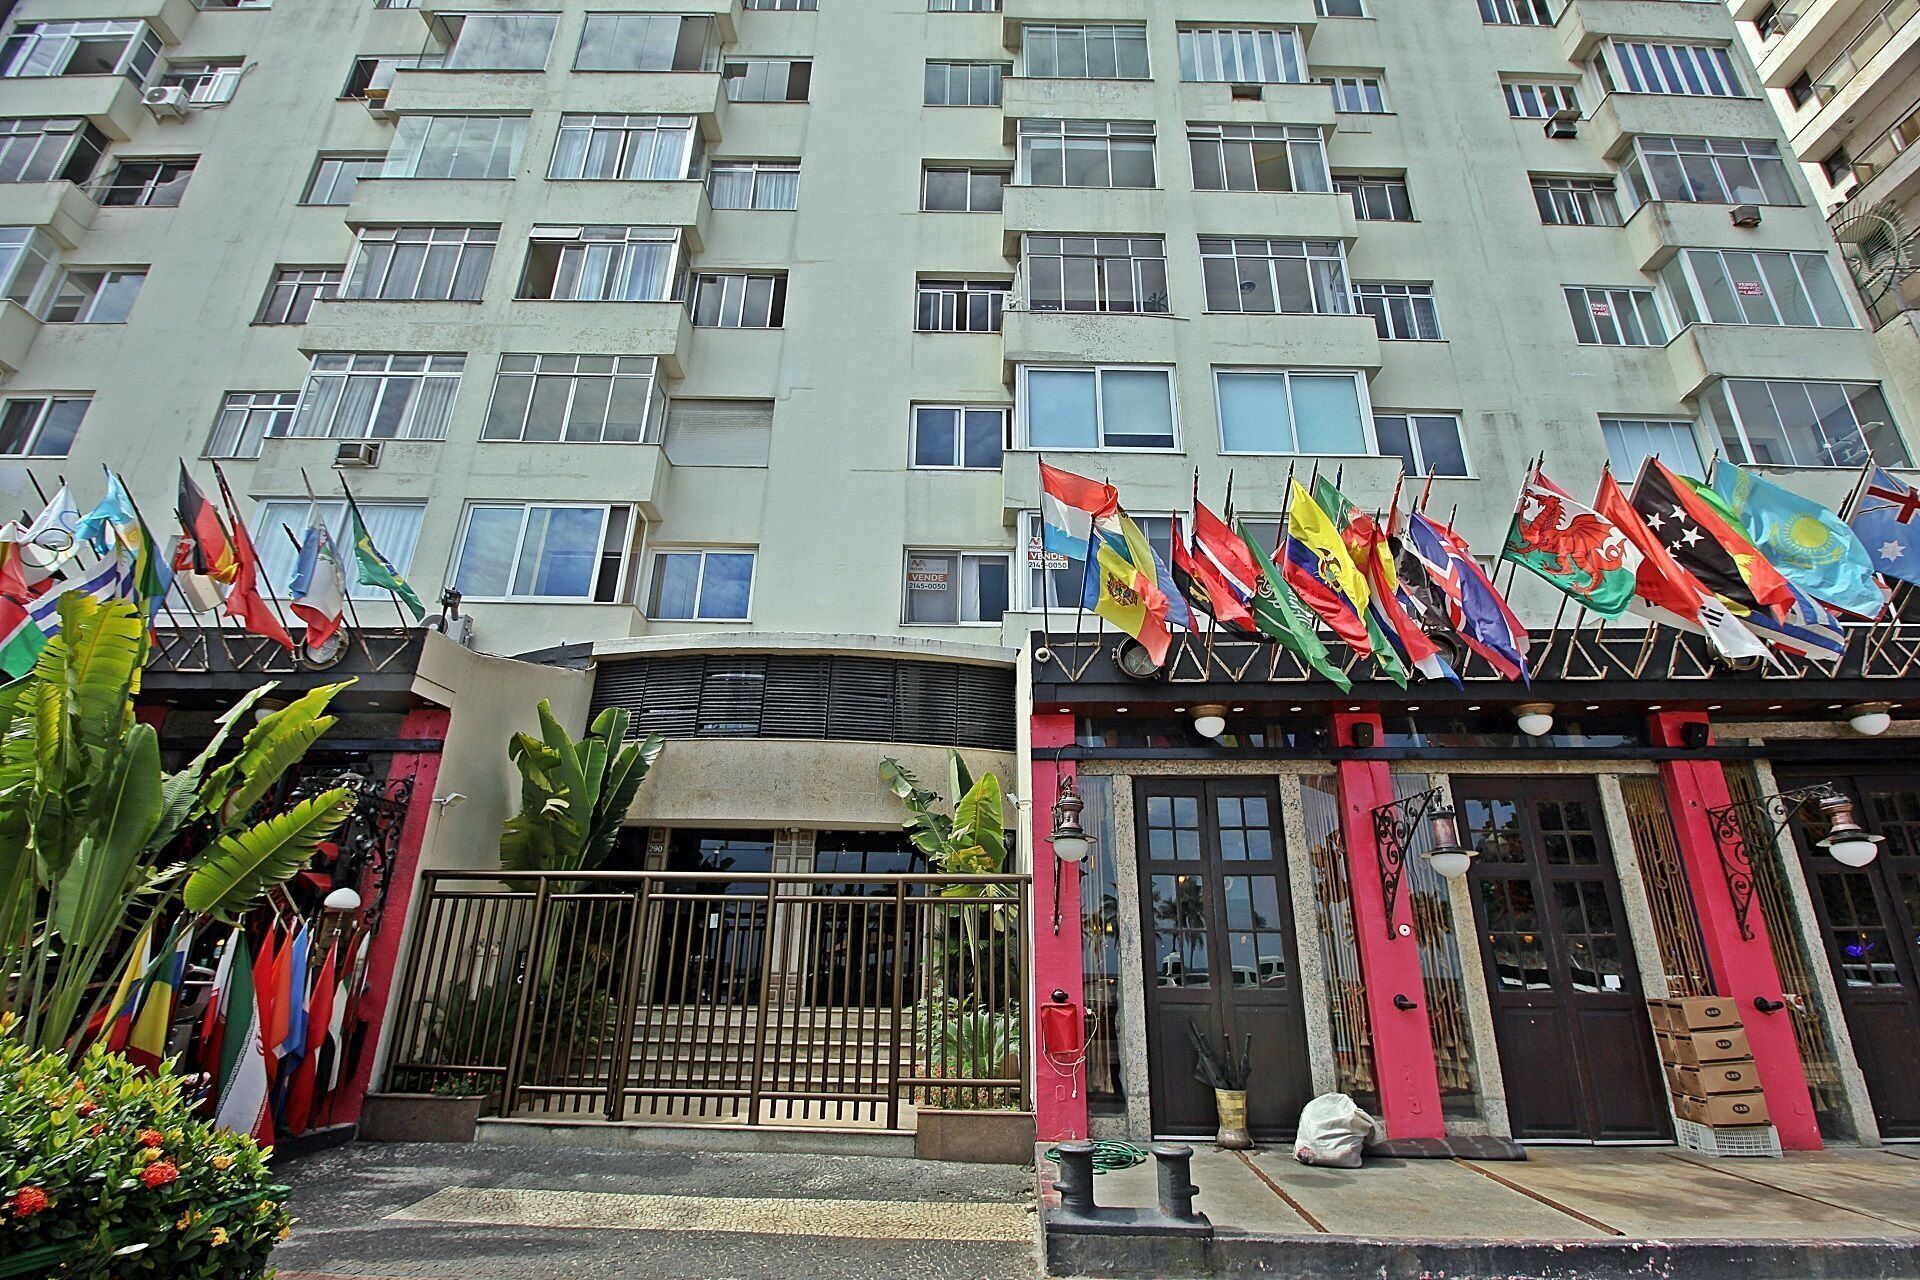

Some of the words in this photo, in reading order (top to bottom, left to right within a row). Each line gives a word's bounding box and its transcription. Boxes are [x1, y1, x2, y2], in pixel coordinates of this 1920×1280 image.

[911, 573, 944, 582] VENDE
[909, 582, 946, 590] 2145-0050
[648, 845, 663, 853] 290
